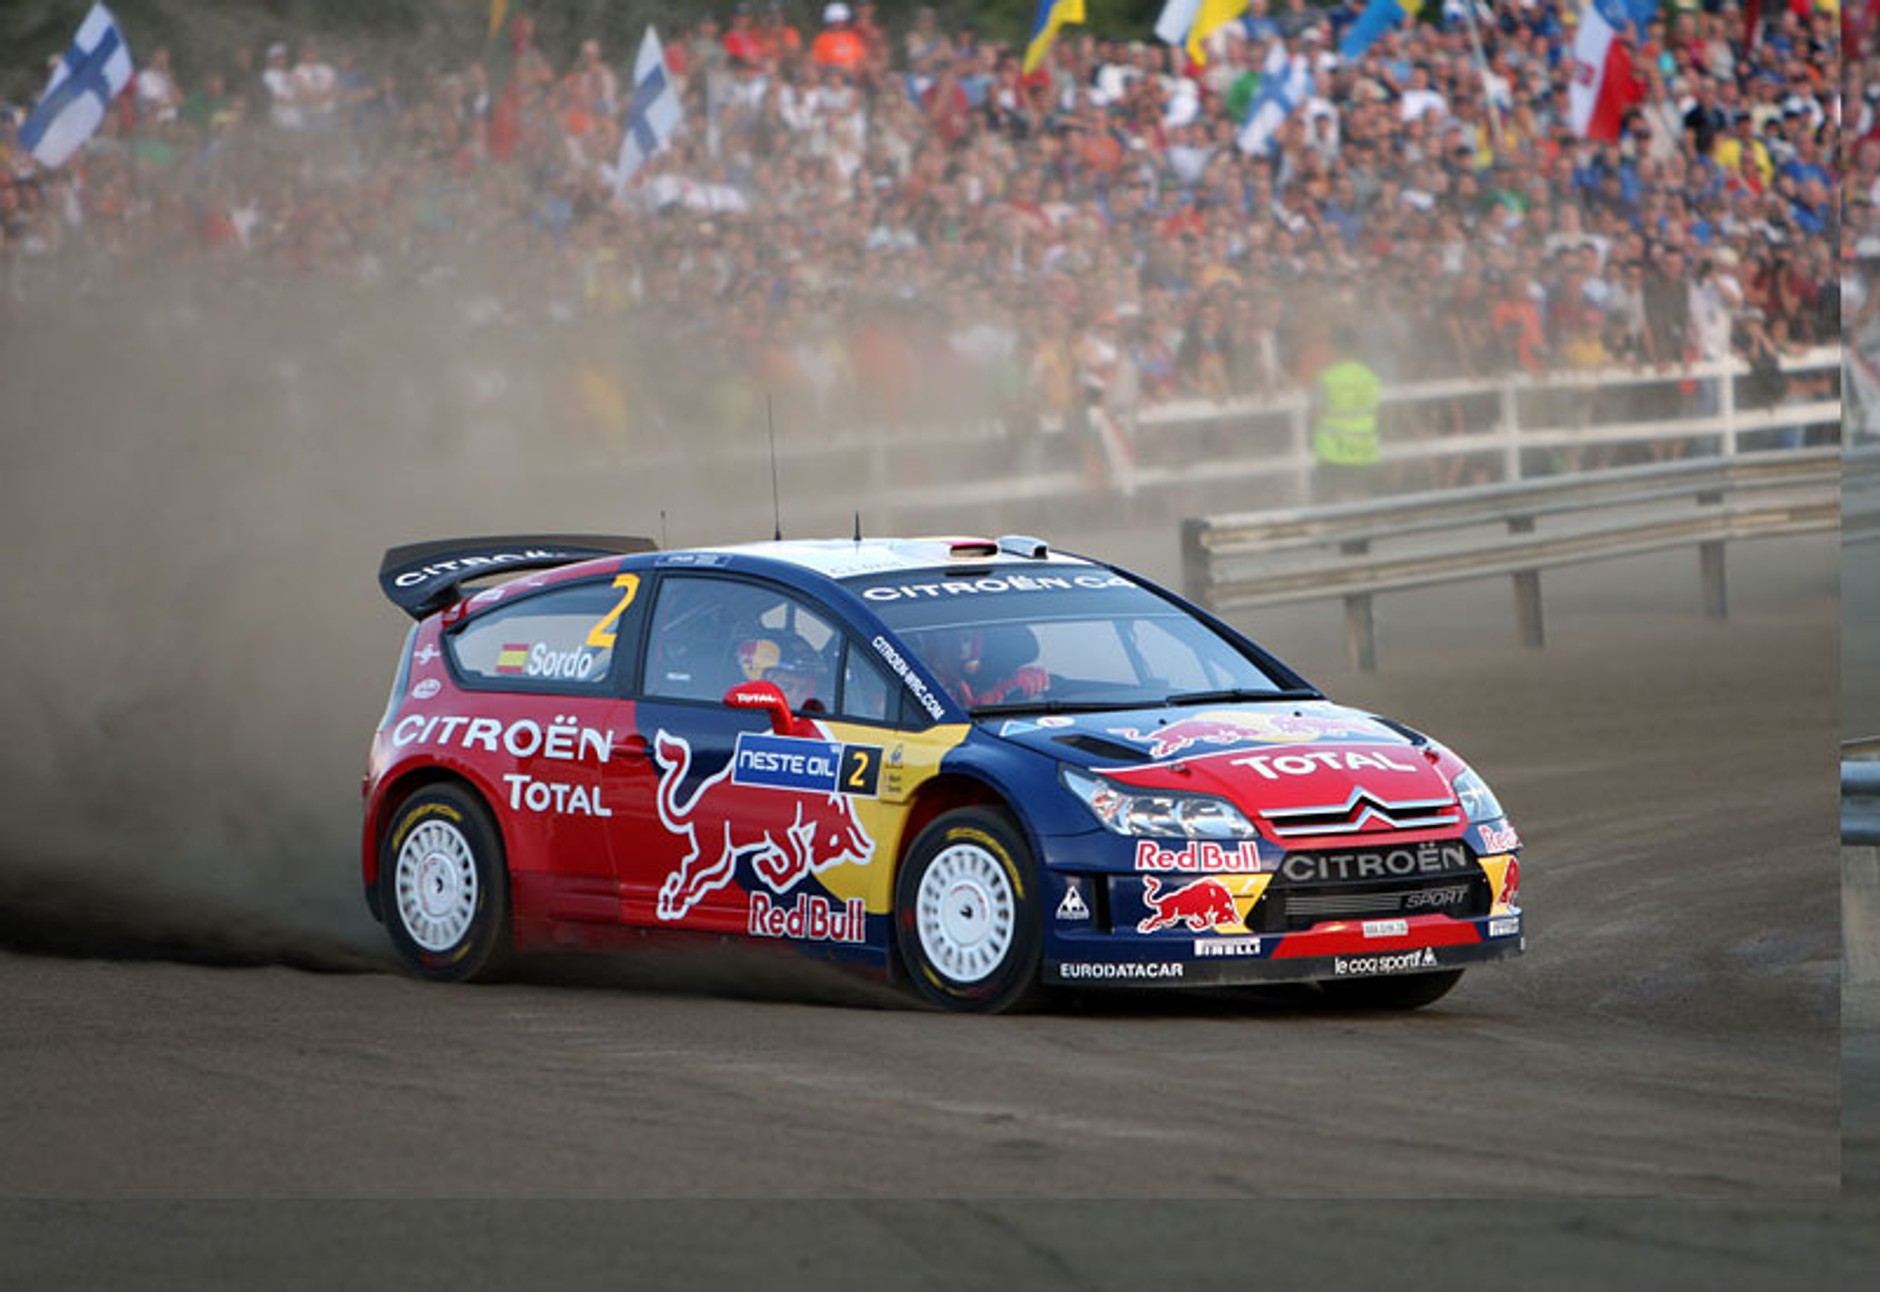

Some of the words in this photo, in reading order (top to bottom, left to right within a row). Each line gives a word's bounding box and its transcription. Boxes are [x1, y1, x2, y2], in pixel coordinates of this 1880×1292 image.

[586, 573, 640, 648] 2
[528, 643, 592, 678] Sordo
[736, 692, 777, 704] TOTAL
[392, 714, 614, 763] CITROËN
[739, 749, 804, 775] NESTE
[805, 757, 836, 777] OIL
[848, 751, 870, 787] 2
[1229, 750, 1419, 780] TOTAL
[502, 773, 613, 817] TOTAL
[1136, 840, 1197, 870] Red
[1200, 842, 1261, 872] Bull
[1282, 842, 1467, 882] CITROËN
[1405, 887, 1466, 910] SPORT
[749, 890, 805, 938] Red
[808, 897, 866, 943] Bull
[1060, 963, 1184, 978] EURODATACAR
